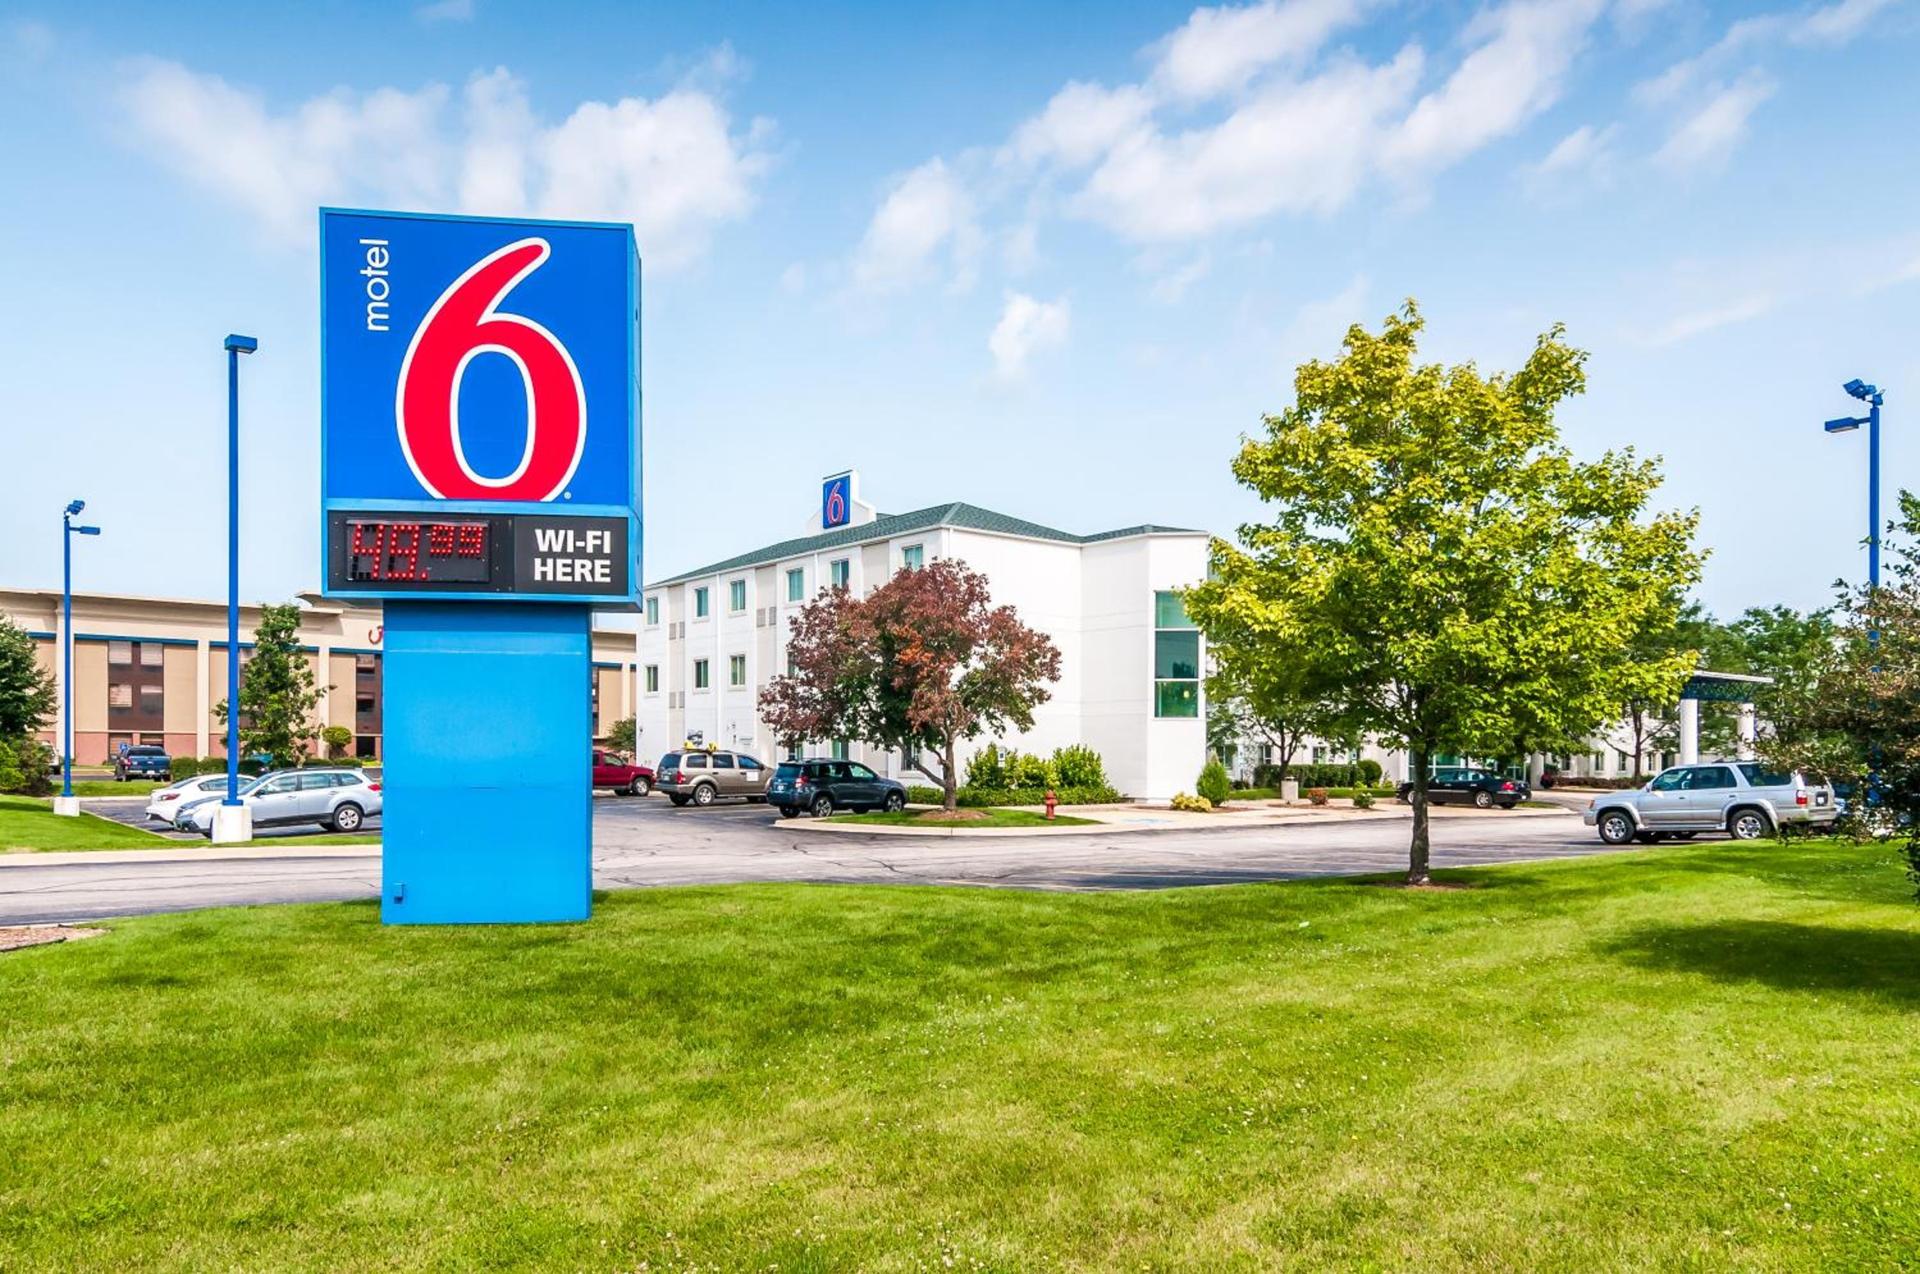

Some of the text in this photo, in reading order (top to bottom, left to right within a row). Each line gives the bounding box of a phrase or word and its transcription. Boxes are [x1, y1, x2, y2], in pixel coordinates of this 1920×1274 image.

[359, 236, 587, 502] motel 6
[827, 481, 844, 525] 6
[534, 528, 612, 554] WI-FI
[533, 558, 612, 583] HERE
